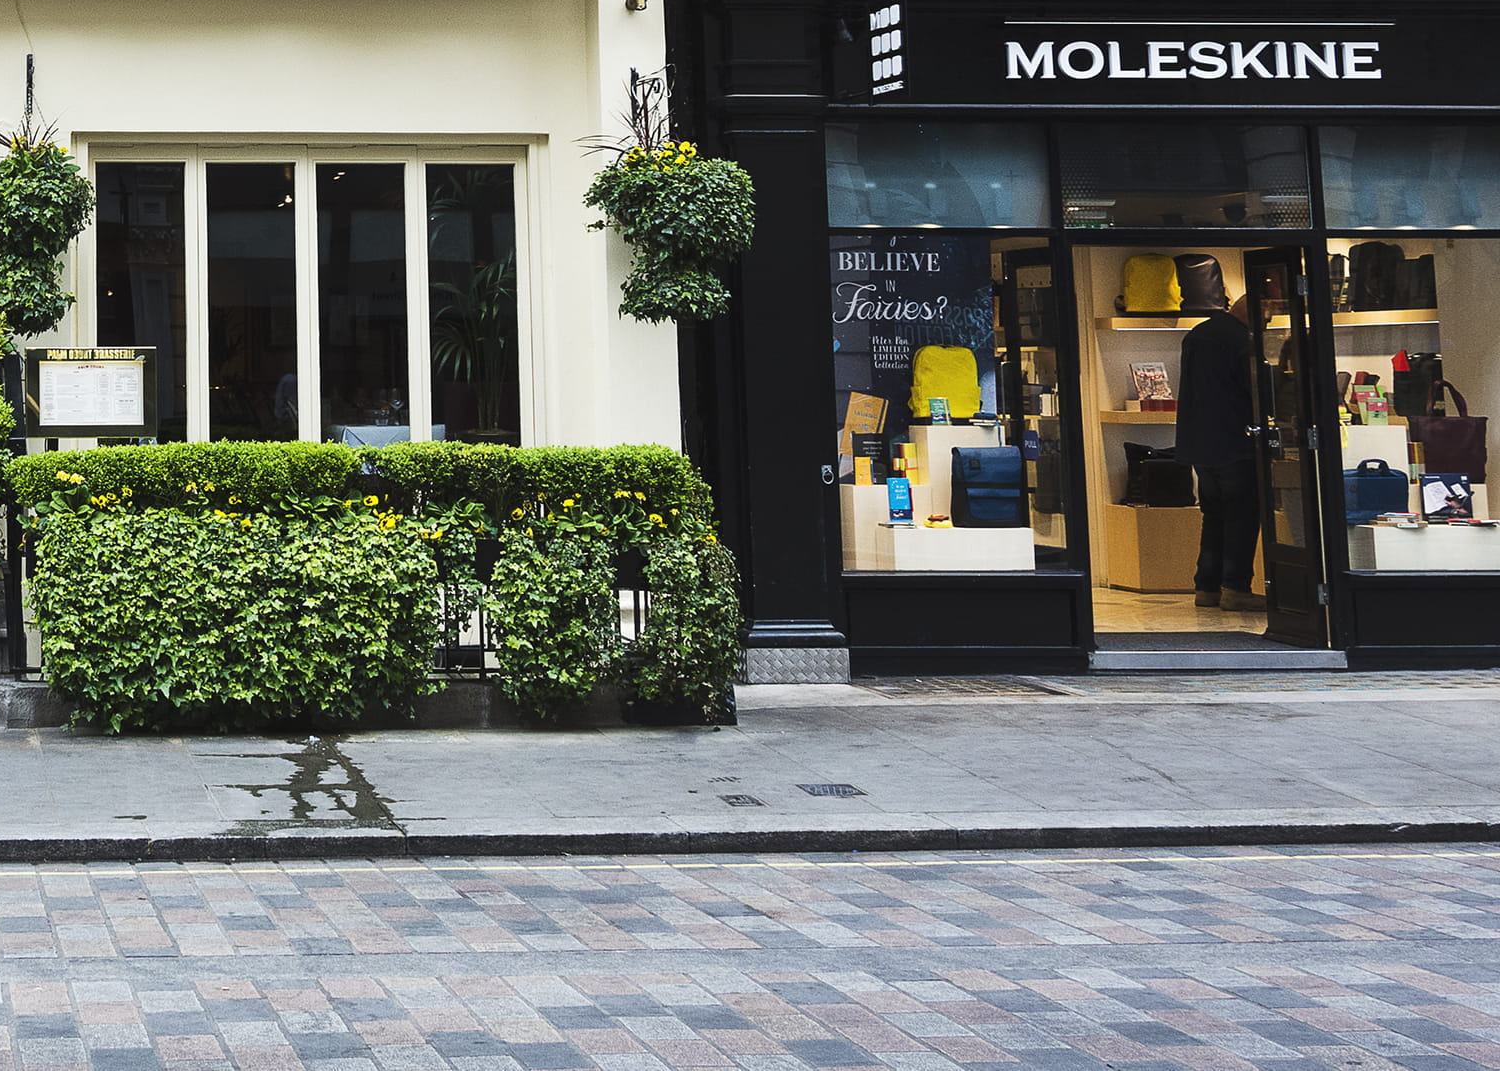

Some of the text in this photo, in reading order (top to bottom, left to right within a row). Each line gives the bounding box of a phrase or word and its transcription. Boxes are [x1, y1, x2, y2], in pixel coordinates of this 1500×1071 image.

[1004, 40, 1383, 80] MOLESKINE
[838, 252, 941, 272] BELIEVE
[885, 279, 896, 293] IN
[832, 281, 948, 323] Fairies?
